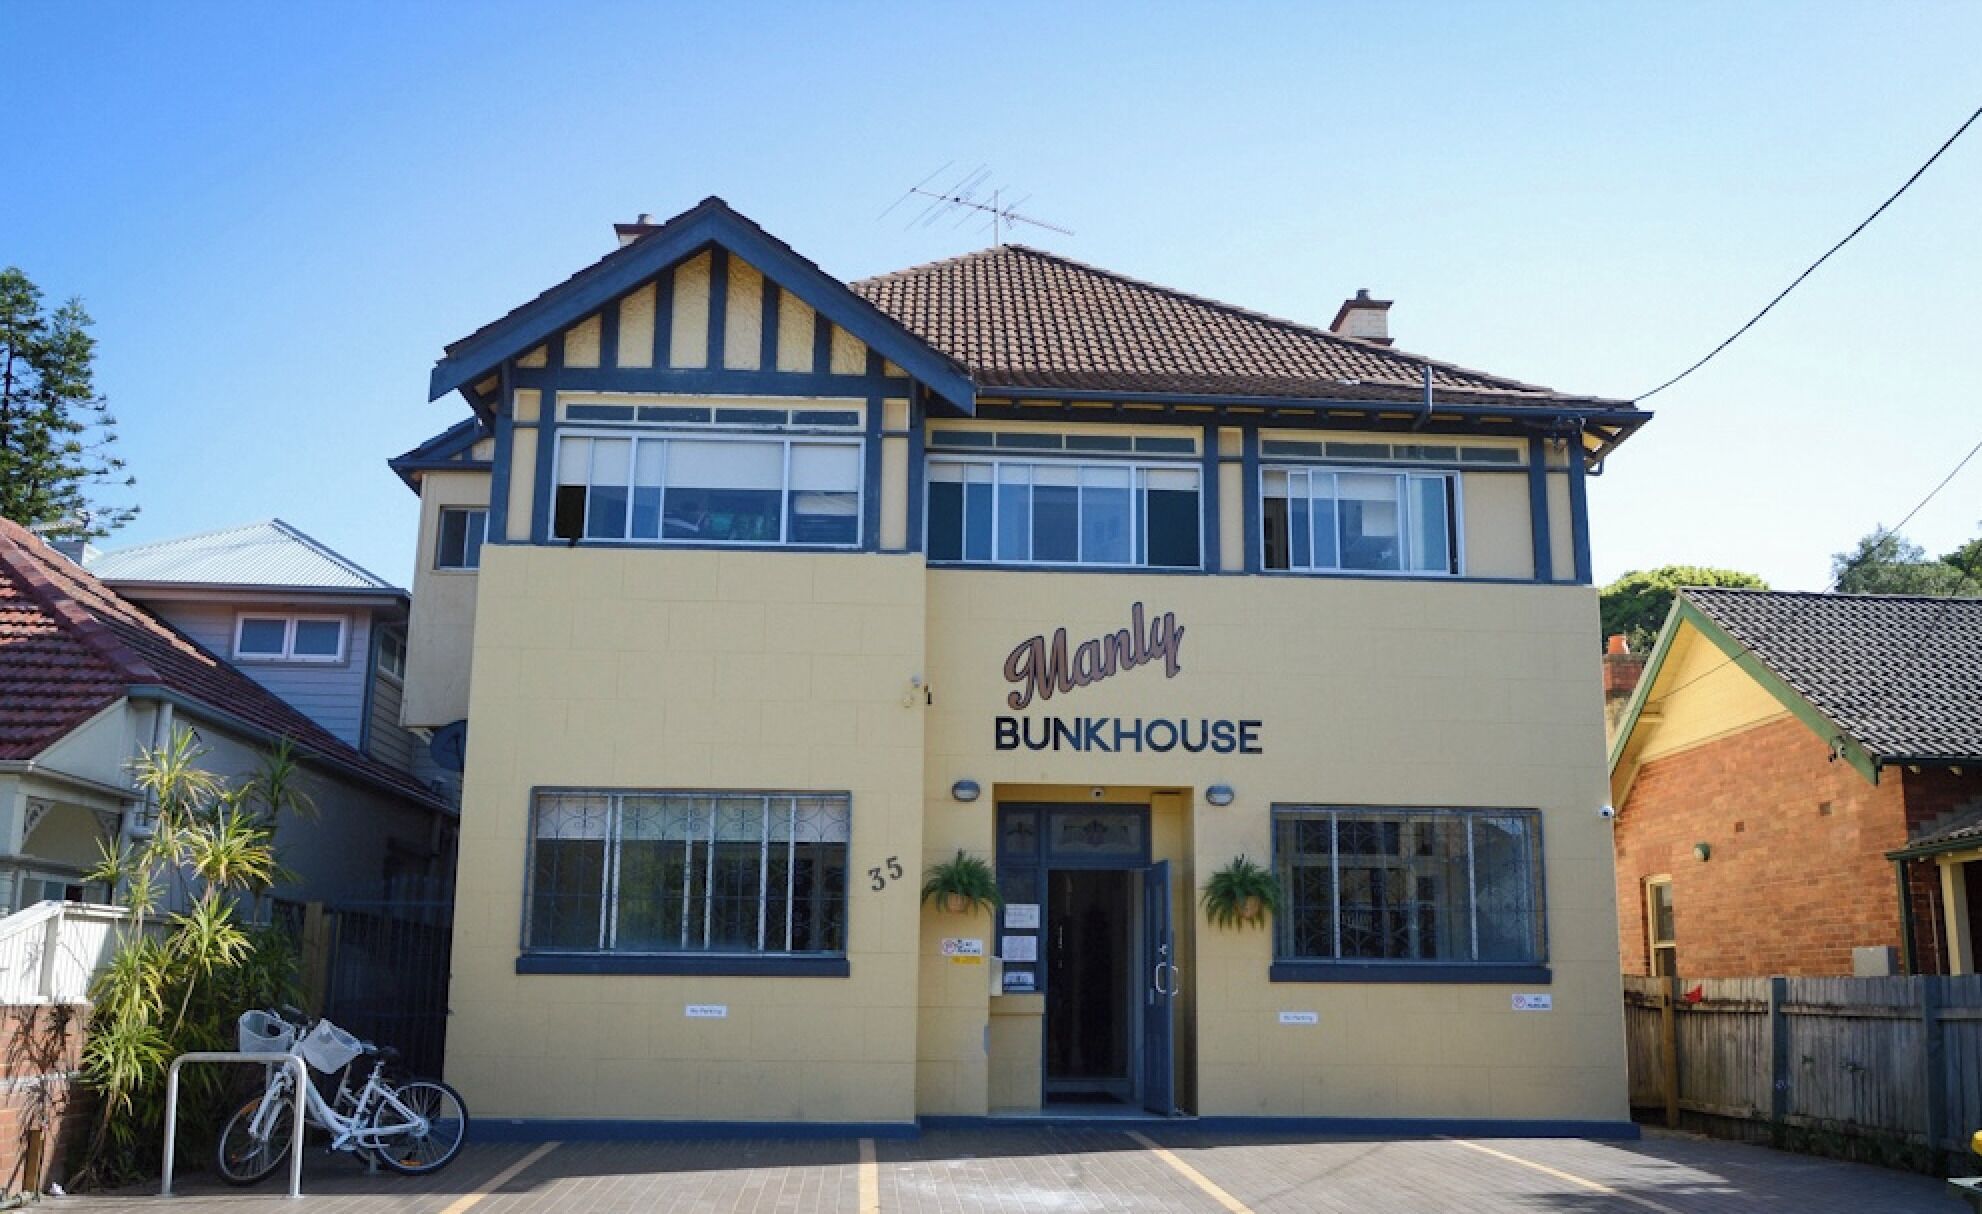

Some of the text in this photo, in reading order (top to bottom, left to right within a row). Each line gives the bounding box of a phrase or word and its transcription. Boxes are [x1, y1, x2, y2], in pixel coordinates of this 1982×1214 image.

[1003, 601, 1185, 710] Manly
[995, 716, 1263, 754] BUNKHOUSE
[868, 855, 903, 892] 35
